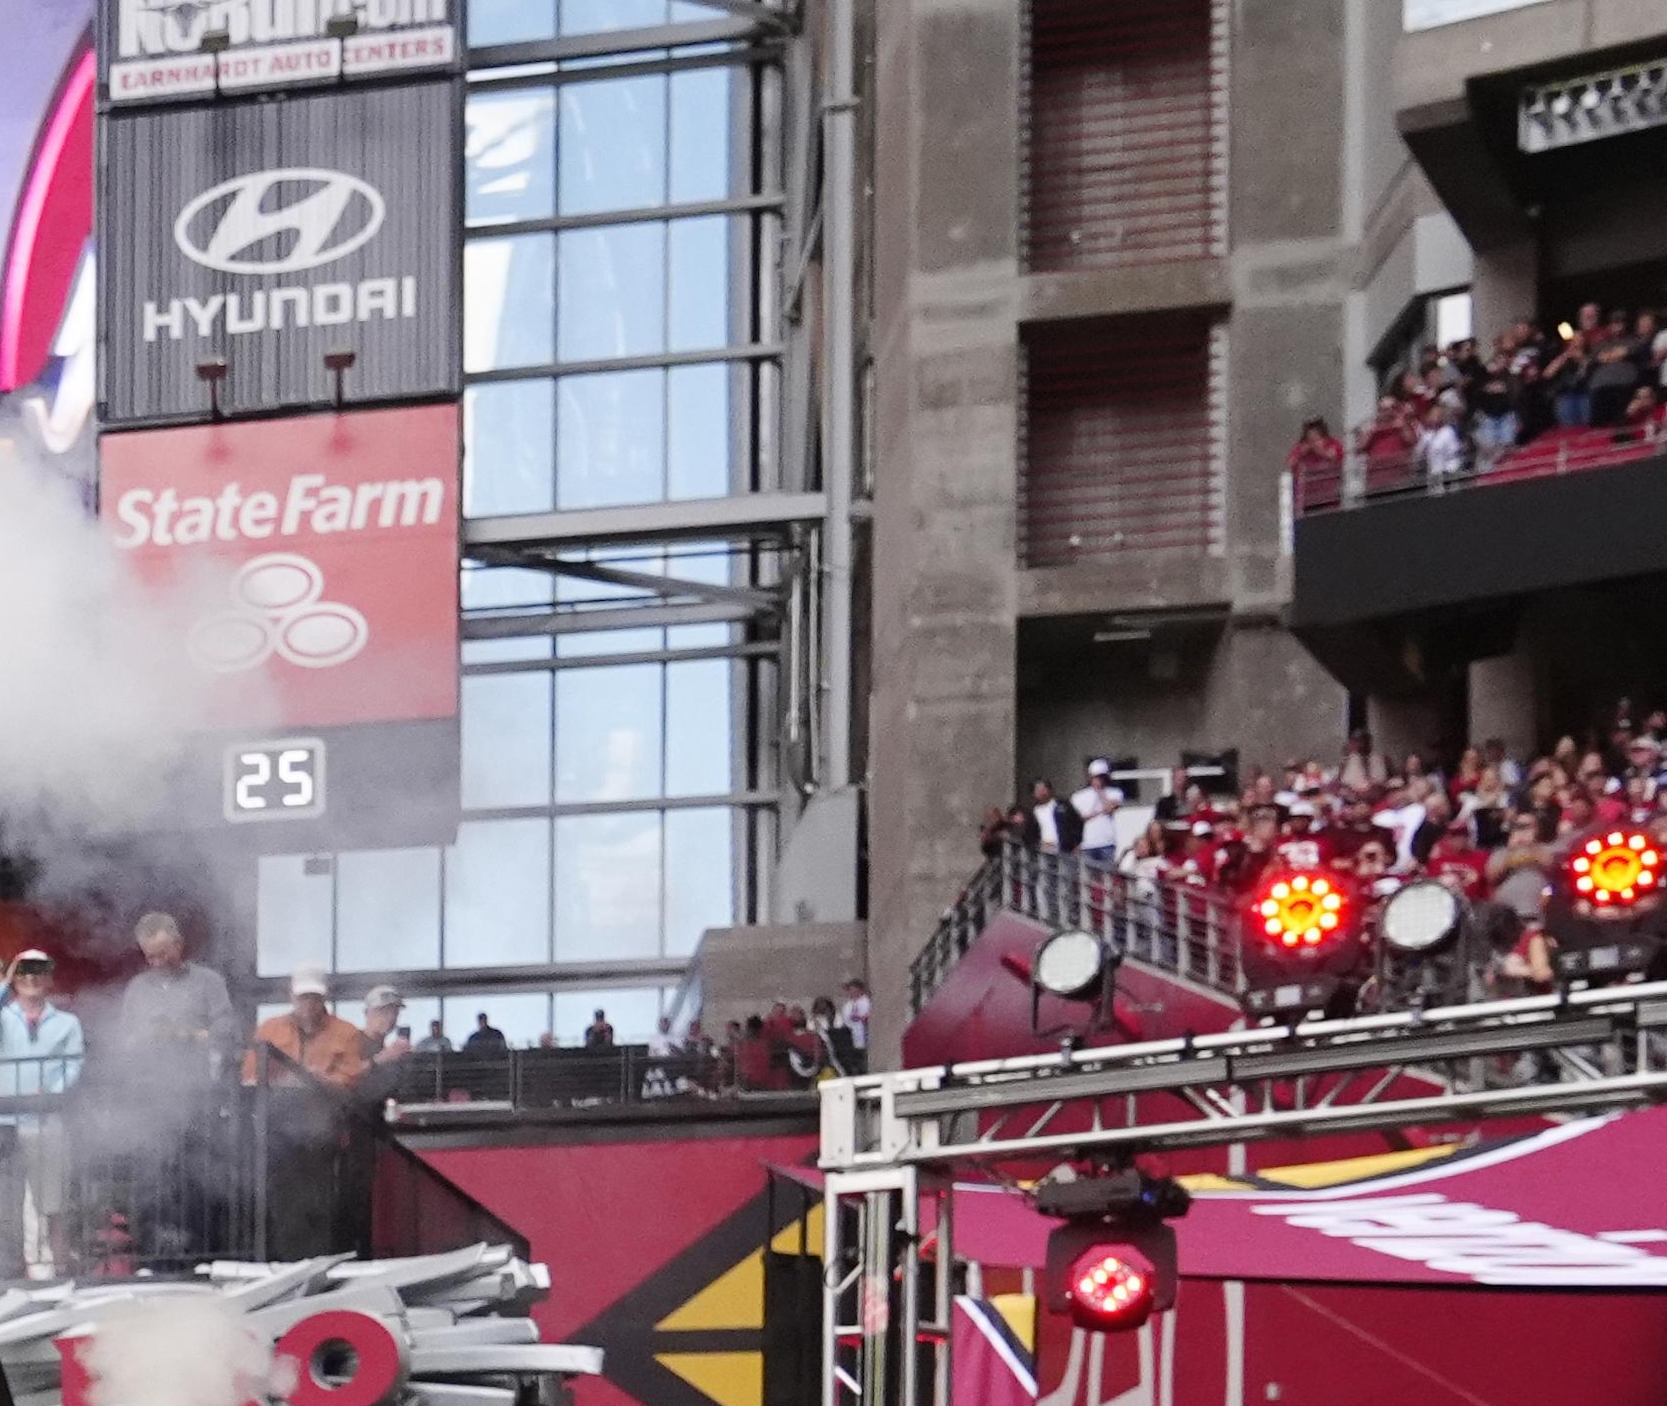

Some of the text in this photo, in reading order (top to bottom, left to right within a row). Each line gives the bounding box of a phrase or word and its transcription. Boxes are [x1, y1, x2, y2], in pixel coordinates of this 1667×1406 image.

[269, 49, 331, 73] AUTO
[343, 37, 445, 65] ENTERS
[143, 275, 417, 343] HYUNDAI
[235, 749, 313, 810] 25
